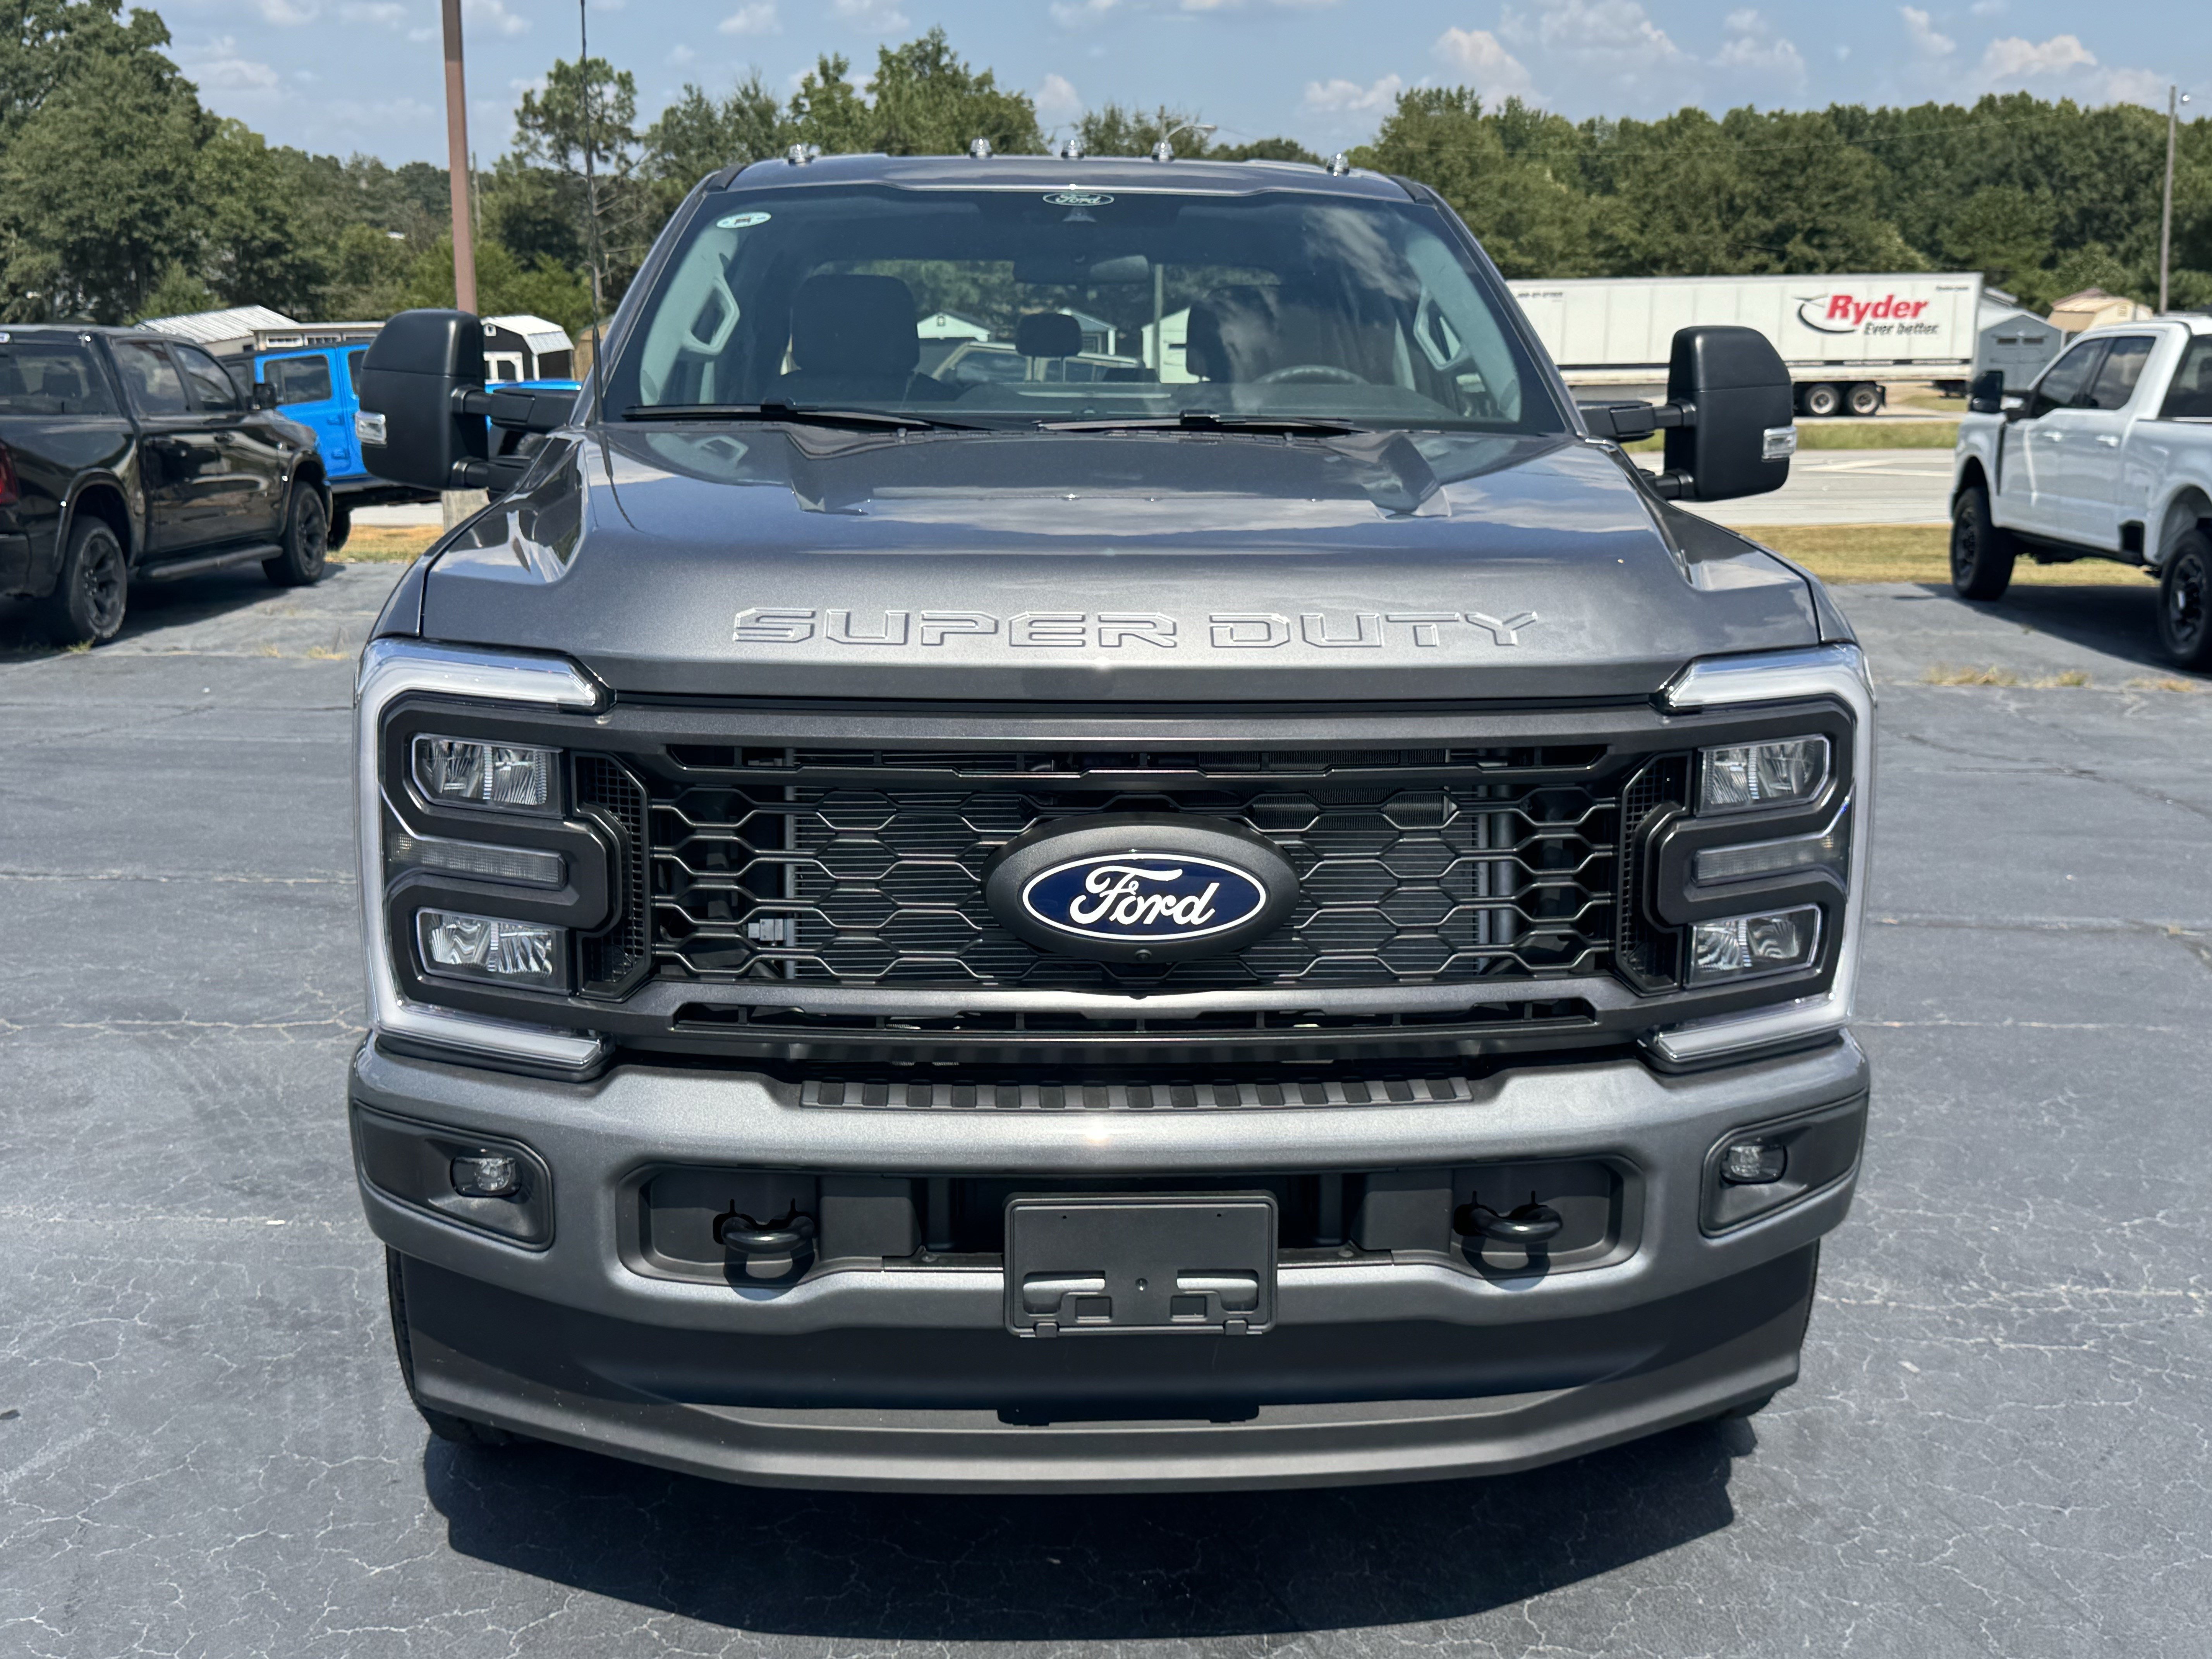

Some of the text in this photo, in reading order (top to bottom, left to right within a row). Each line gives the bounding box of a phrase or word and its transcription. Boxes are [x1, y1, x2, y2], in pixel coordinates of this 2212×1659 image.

[1055, 194, 1101, 203] Ford
[1827, 295, 1929, 325] Ryder
[1864, 322, 1894, 335] Ever
[733, 607, 1538, 647] SUPER DUTY
[1070, 866, 1219, 925] Ford
